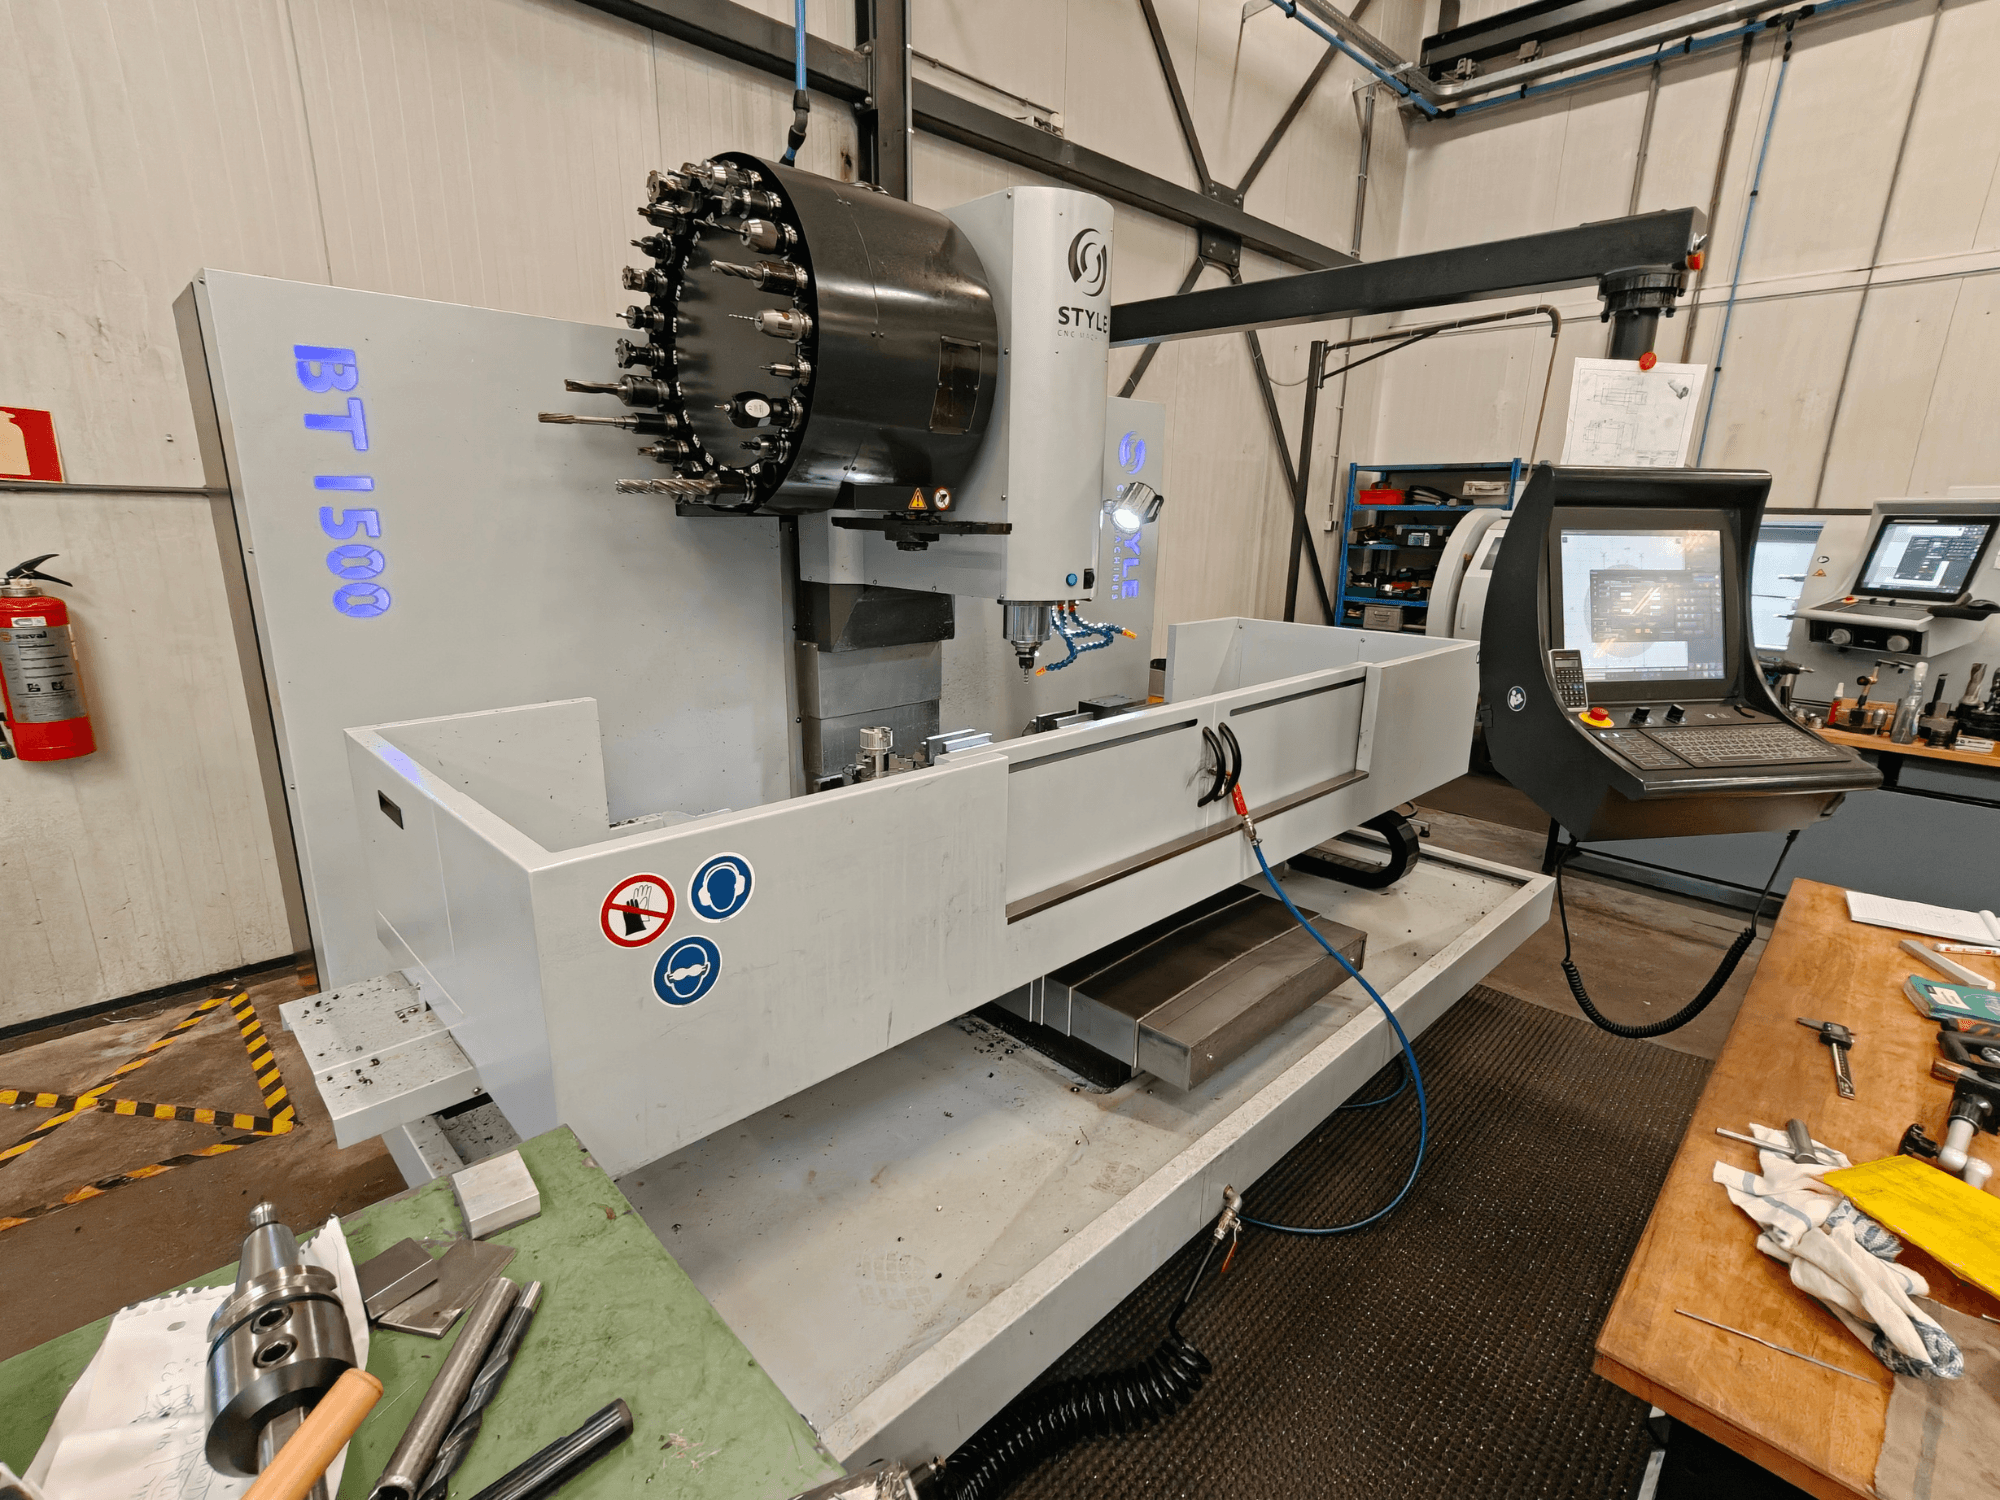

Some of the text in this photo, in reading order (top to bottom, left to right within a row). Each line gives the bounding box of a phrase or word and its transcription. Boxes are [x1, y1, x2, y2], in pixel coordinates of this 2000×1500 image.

[1058, 306, 1107, 333] STYLE
[293, 344, 391, 618] BT 1500
[1121, 532, 1142, 599] YLE
